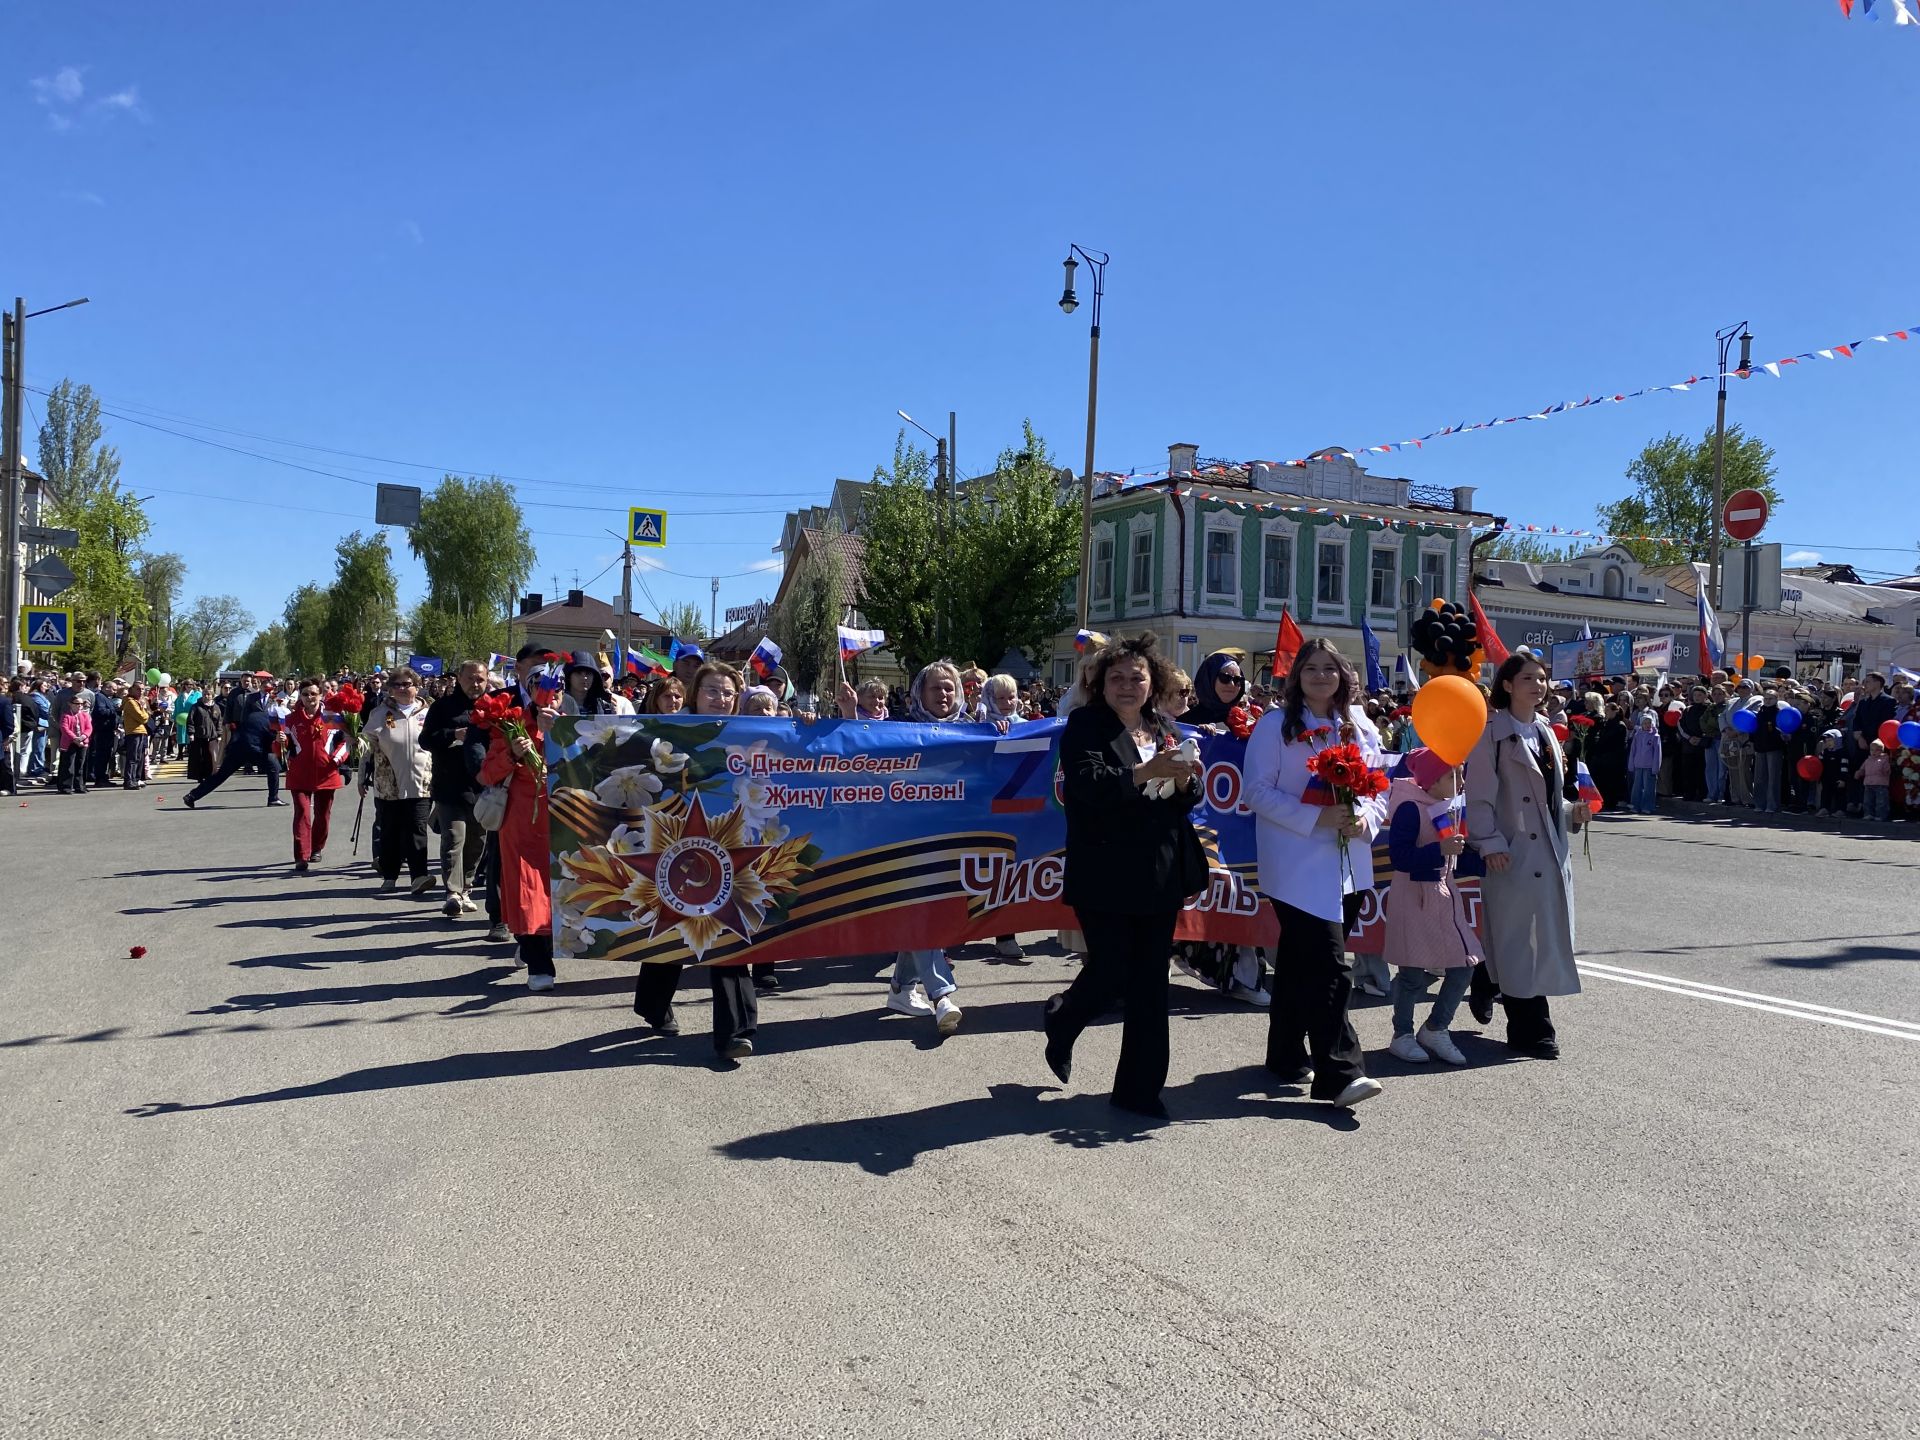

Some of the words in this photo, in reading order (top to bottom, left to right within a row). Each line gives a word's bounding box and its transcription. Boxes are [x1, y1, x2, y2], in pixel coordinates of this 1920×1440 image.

[1782, 589, 1803, 601] рма
[1525, 630, 1554, 645] café
[1633, 639, 1668, 656] ЬСКИЙ
[1673, 643, 1690, 660] фе
[727, 753, 746, 775] С
[751, 753, 814, 778] Днем
[818, 753, 921, 774] Победы!
[832, 784, 885, 804] көне
[889, 779, 965, 802] белән!
[659, 839, 727, 911] ОТЕЧЕСТВЕННАЯ
